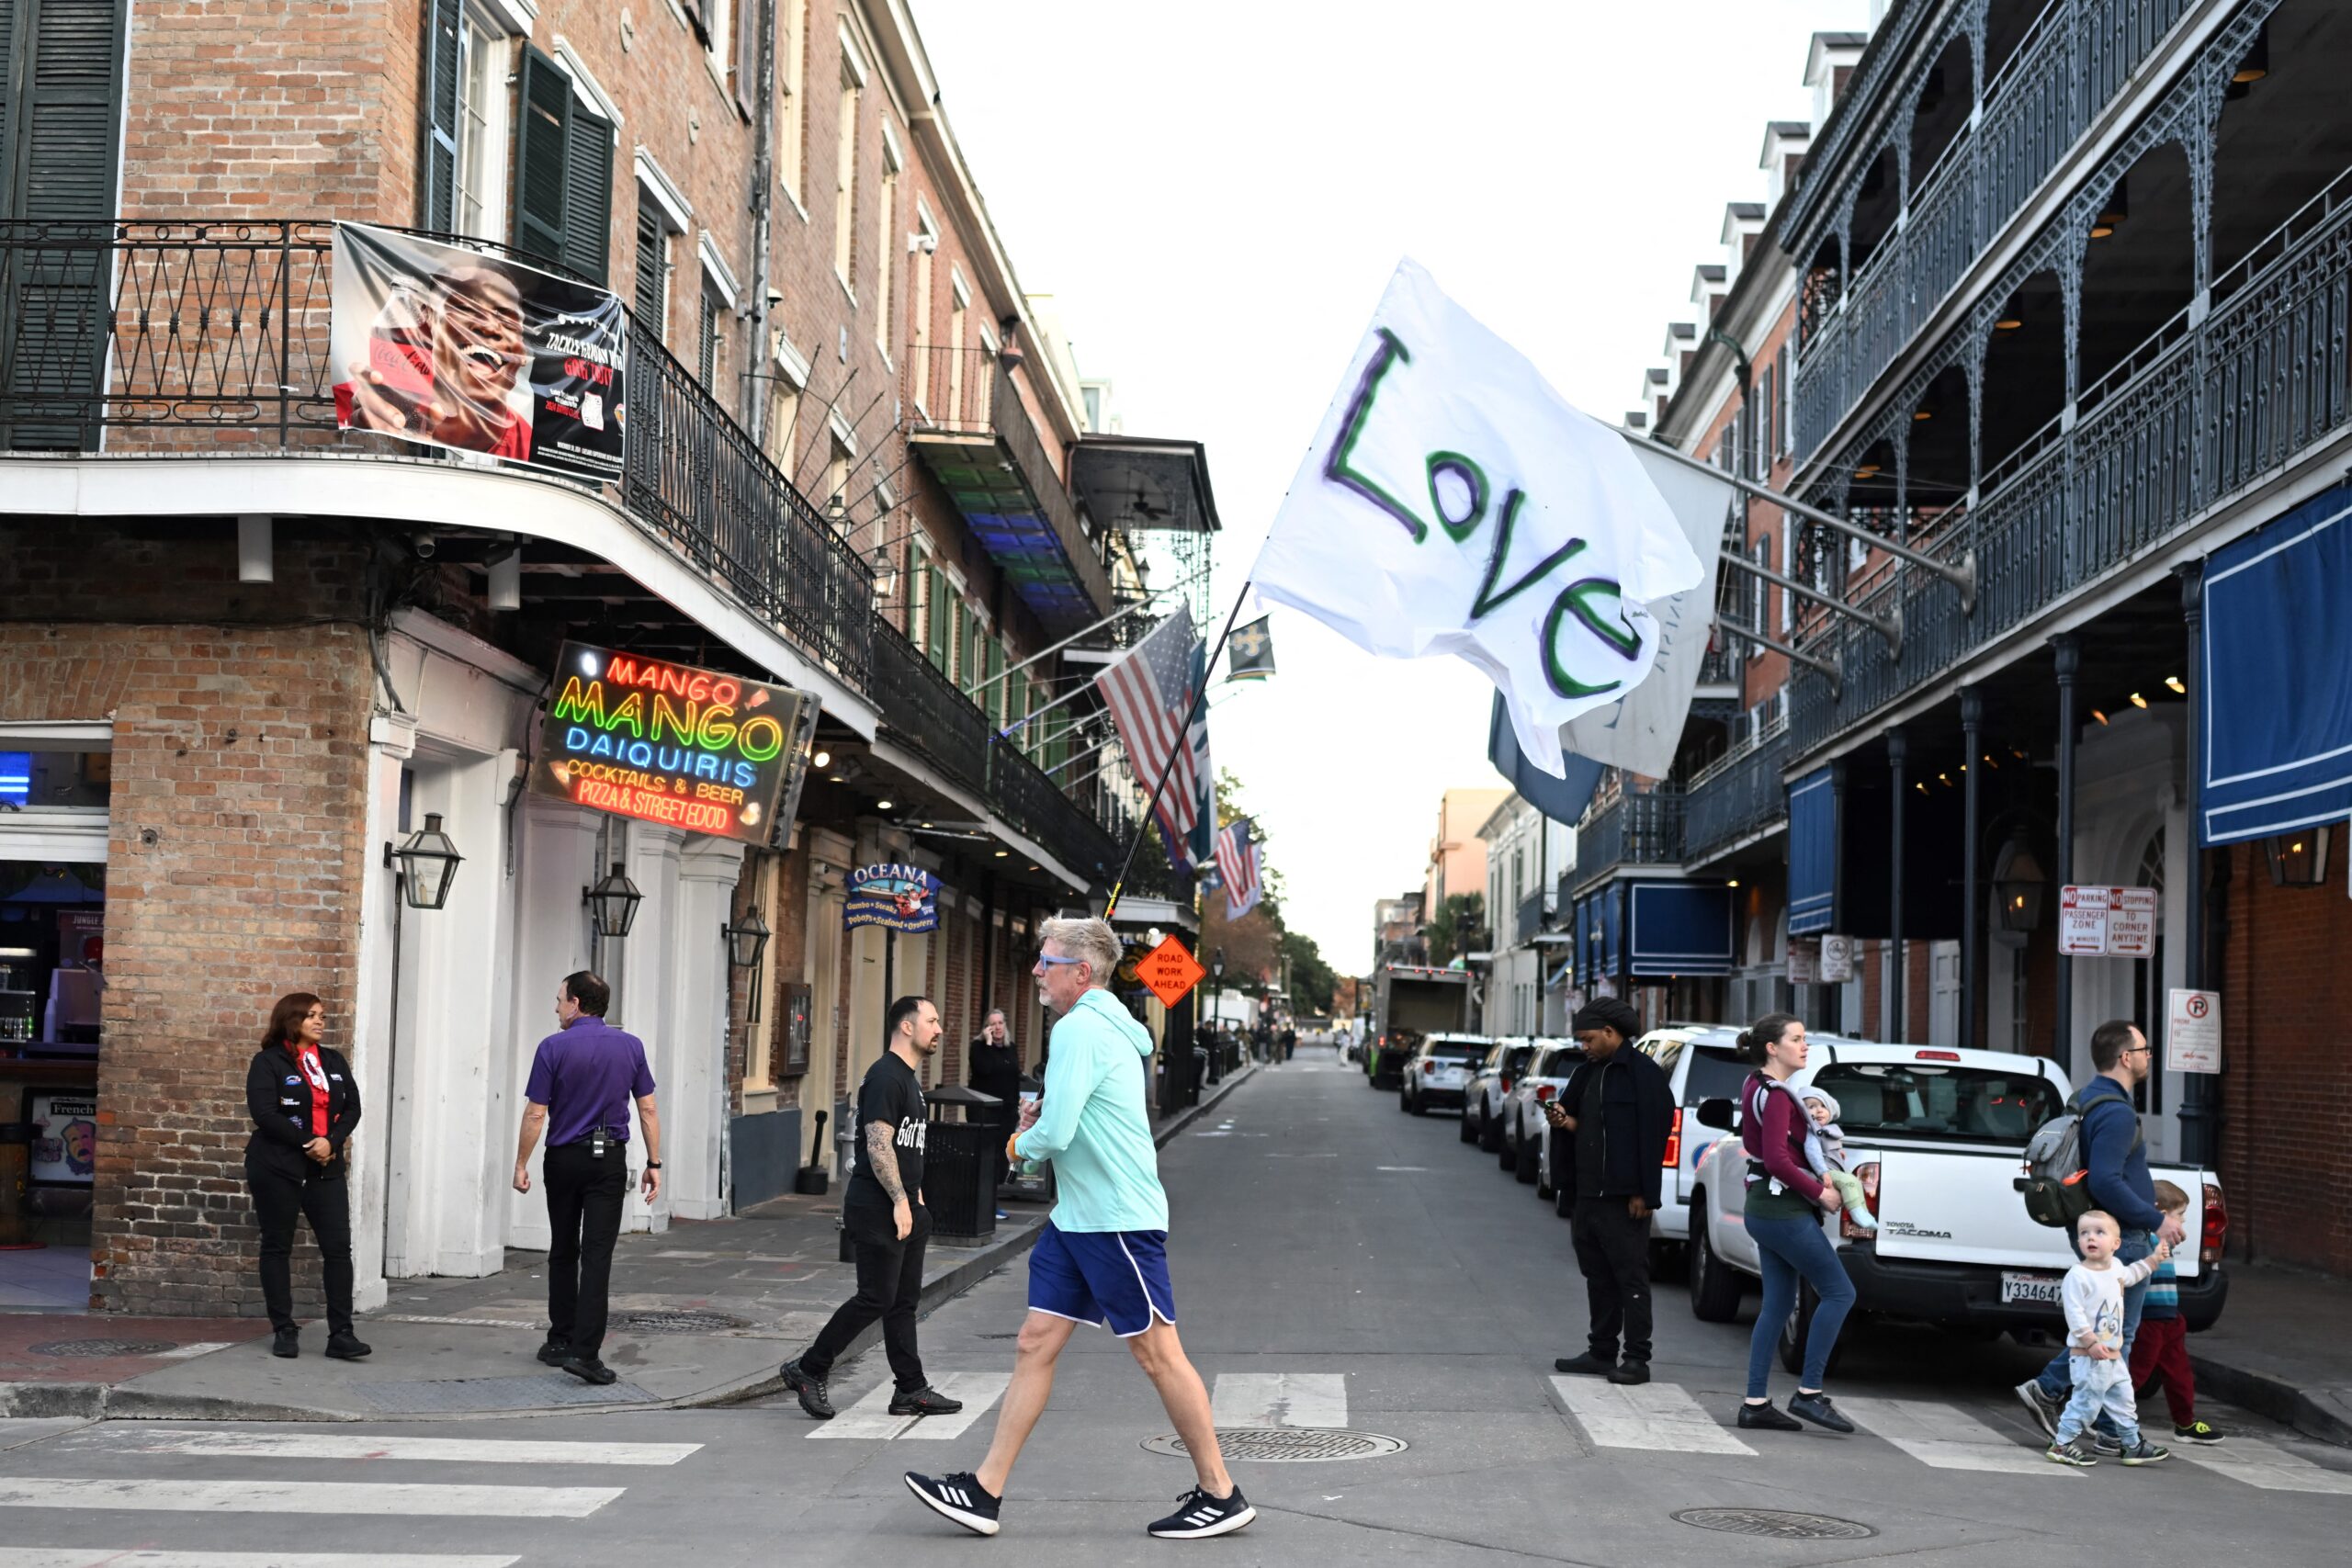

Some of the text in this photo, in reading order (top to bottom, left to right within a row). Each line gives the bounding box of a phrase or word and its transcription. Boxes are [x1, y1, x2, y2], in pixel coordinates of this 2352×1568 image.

[547, 333, 580, 355] TACKLE
[606, 657, 737, 705] MANGO
[555, 675, 782, 761] MANGO
[566, 727, 757, 787] DAIQUIRIS
[567, 759, 744, 806] COCKTAILS & BEER
[579, 780, 727, 829] PIZZA & STREET FOOD
[854, 863, 927, 886] OCEANA
[2064, 890, 2107, 904] NO PARKING
[2110, 894, 2153, 906] NO STOPPING
[846, 902, 898, 914] Gumbo Steaks
[73, 915, 97, 925] JUNGLE
[2064, 910, 2106, 919] PASSENGER
[876, 916, 904, 929] Seafood
[908, 919, 933, 930] Oysters
[2073, 920, 2097, 929] ZONE
[2113, 922, 2148, 932] CORNER
[2112, 934, 2148, 943] ANYTIME
[1158, 954, 1183, 963] ROAD
[1157, 967, 1182, 976] WORK
[1154, 980, 1186, 989] AHEAD
[54, 1104, 94, 1114] French
[1885, 1228, 1952, 1239] TACOMA
[2006, 1281, 2062, 1302] Y334647
